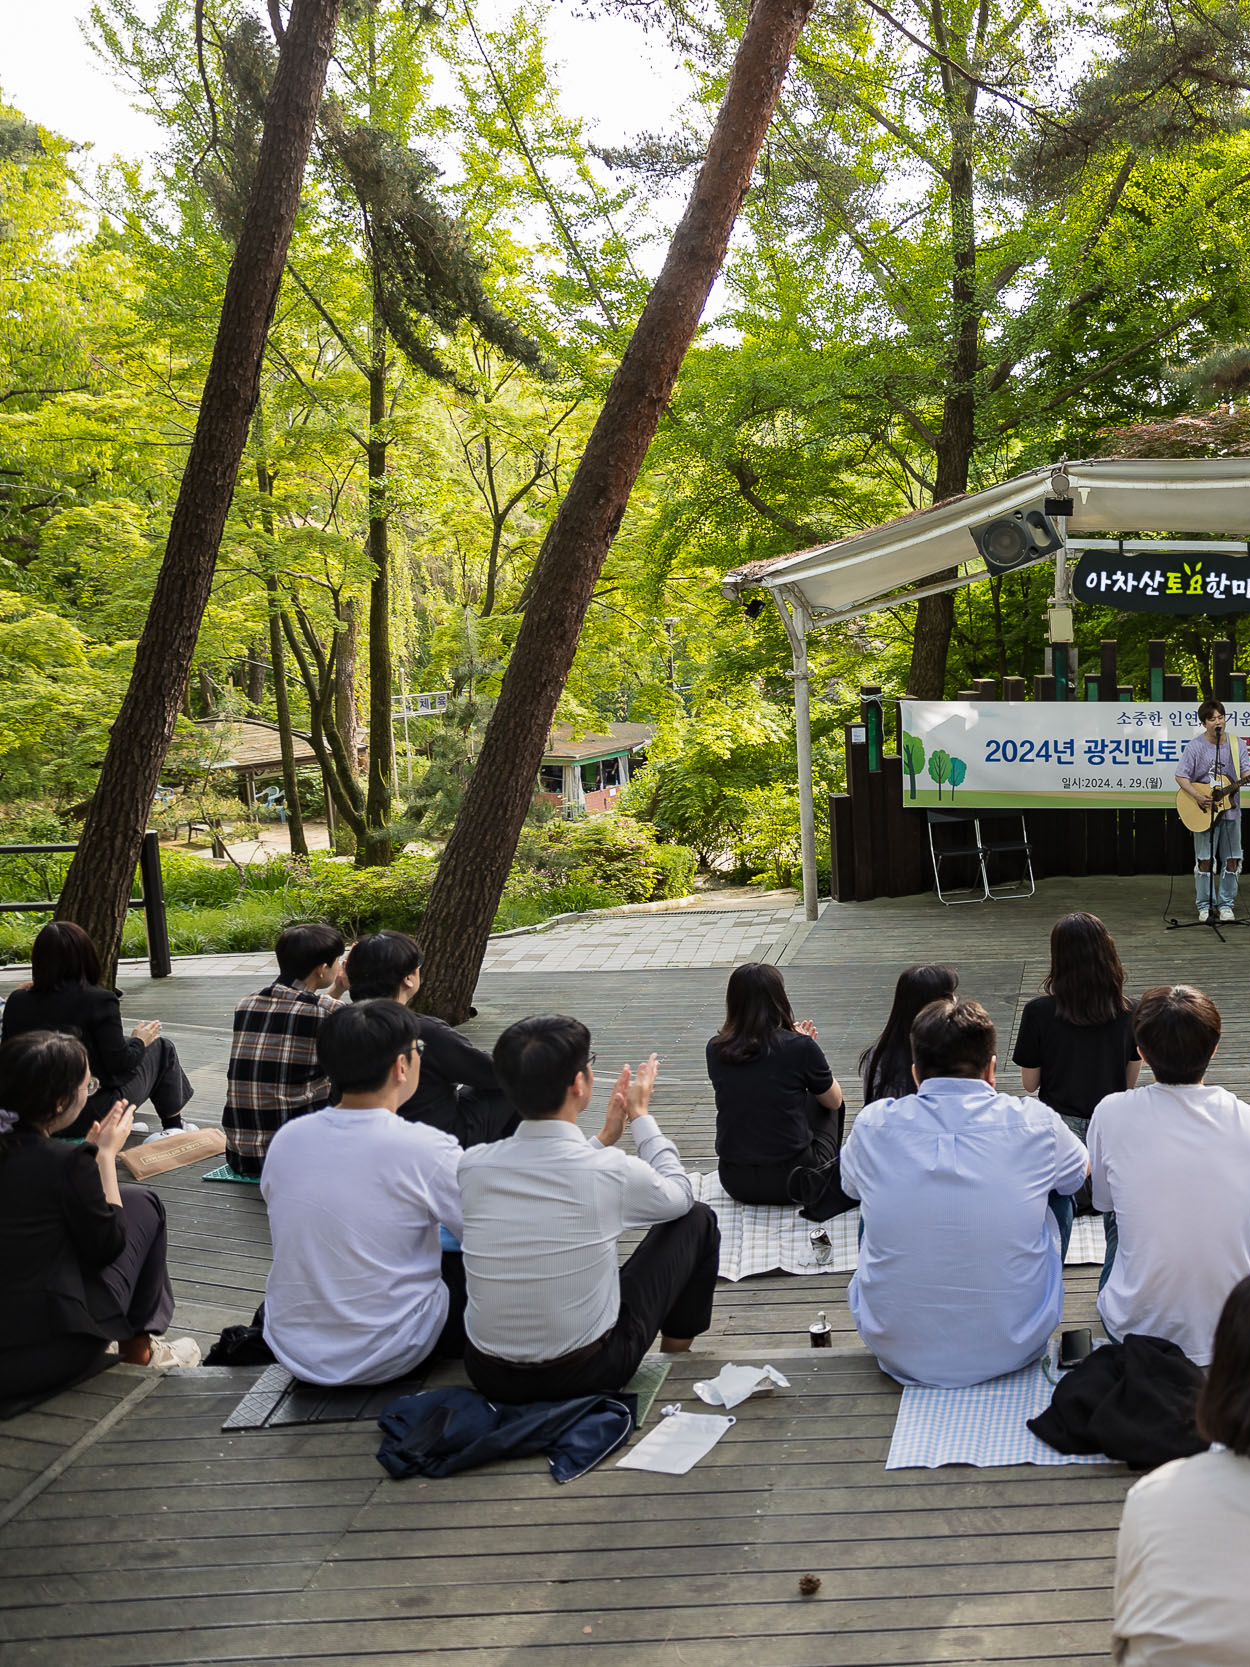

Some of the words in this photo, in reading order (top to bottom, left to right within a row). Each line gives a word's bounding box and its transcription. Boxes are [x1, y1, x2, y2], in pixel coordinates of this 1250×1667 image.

[1116, 710, 1163, 727] 소중한
[984, 738, 1075, 766] 2024년
[1083, 738, 1192, 766] 광진멘토
[1116, 777, 1127, 789] 4.
[1128, 776, 1163, 790] 29.(월)
